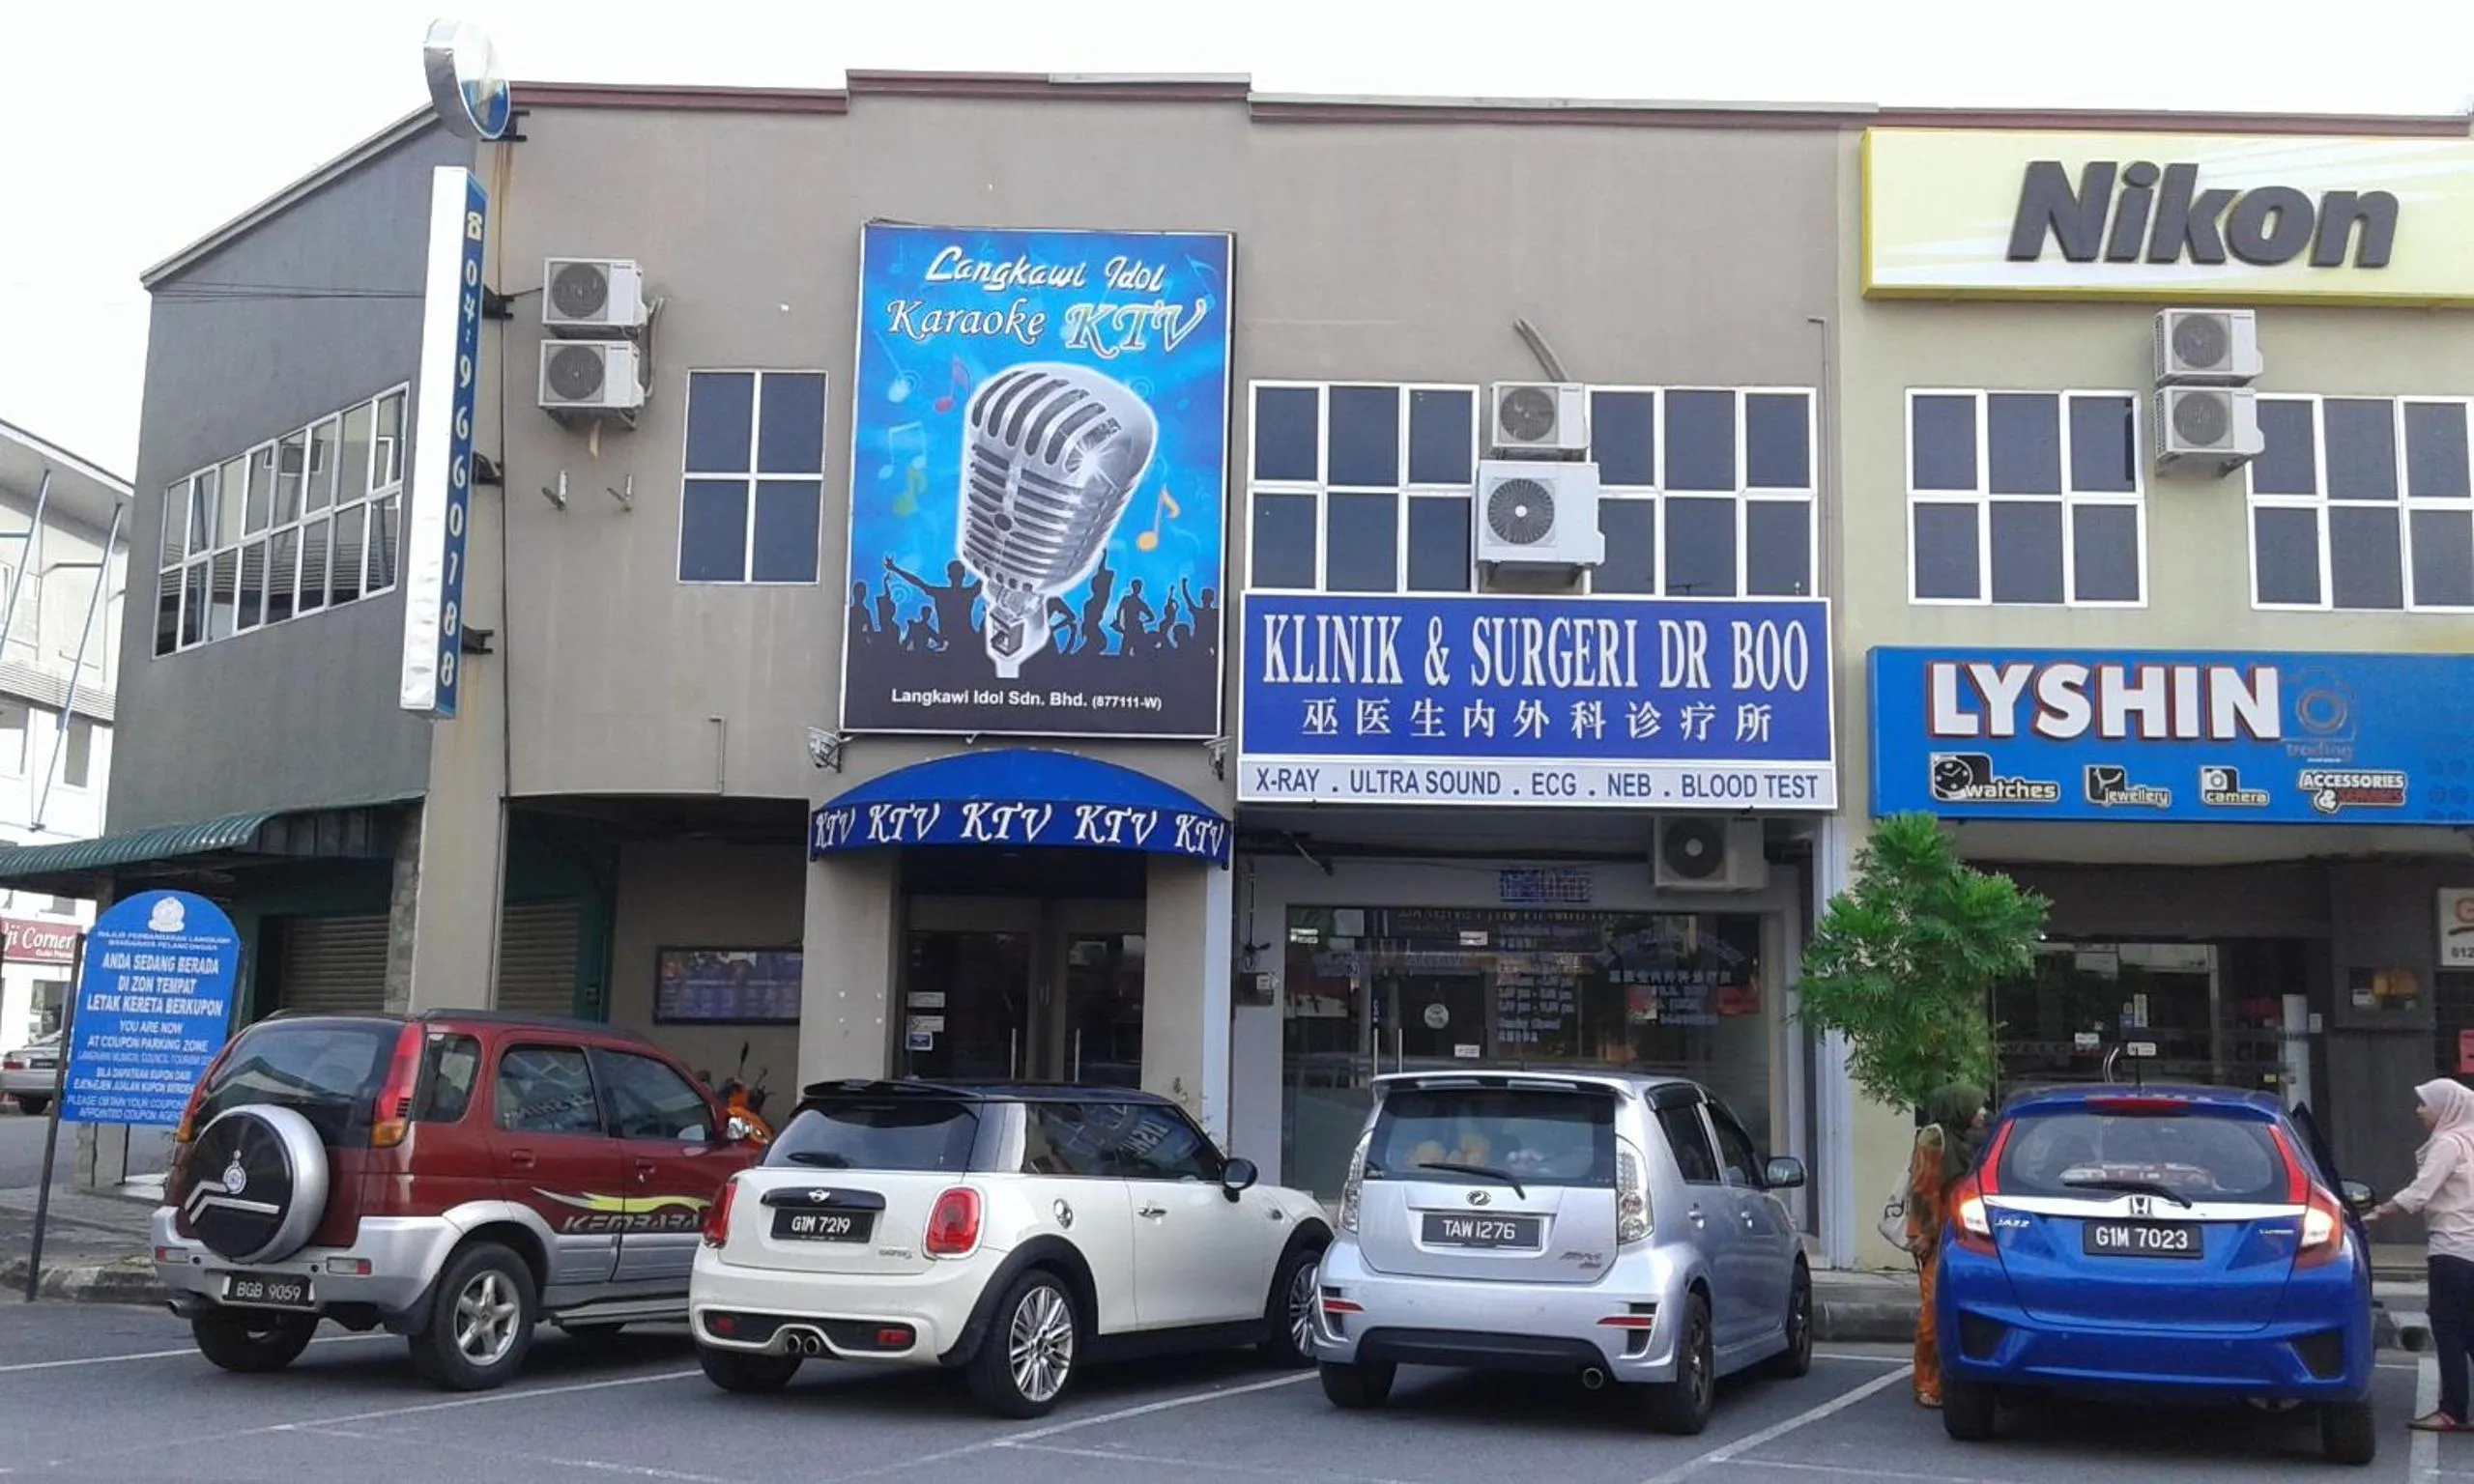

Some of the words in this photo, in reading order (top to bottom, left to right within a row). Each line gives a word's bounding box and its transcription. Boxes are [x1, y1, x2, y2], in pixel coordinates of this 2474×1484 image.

[2005, 160, 2400, 269] Nikon
[925, 245, 1086, 292] Langkawi
[1105, 256, 1165, 292] Idol
[885, 298, 1046, 344] Karaoke
[1064, 300, 1208, 359] KTV
[1263, 614, 1403, 685] KLINIK
[1424, 616, 1450, 687] &
[1471, 615, 1637, 690] SURGERI
[1659, 618, 1712, 690] DR
[1732, 619, 1809, 693] BOO
[891, 689, 968, 706] Langkawi
[973, 690, 1004, 704] Idol
[1008, 691, 1045, 706] Sdn.
[1050, 692, 1087, 706] Bhd.
[1092, 696, 1163, 711] (877111-W)
[1928, 661, 2282, 741] LYSHIN
[1301, 698, 1773, 744] 巫医生内外科诊疗所
[1255, 768, 1320, 793] X-RAY
[1349, 769, 1420, 794] ULTRA
[1425, 771, 1501, 796] SOUND
[1531, 772, 1577, 797] ECG
[1607, 773, 1653, 798] NEB
[1682, 774, 1759, 800] BLOOD
[1764, 775, 1819, 800] TEST
[1966, 781, 2057, 799] watches
[2303, 773, 2404, 788] ACCESSORIES
[2103, 787, 2169, 805] jewellery
[2206, 791, 2267, 803] camera
[2318, 788, 2337, 809] &
[815, 808, 856, 849] KTV
[867, 802, 941, 842] KTV
[962, 802, 1053, 843] KTV
[1074, 804, 1158, 845] KTV
[1174, 813, 1225, 857] KTV
[22, 926, 75, 950] Corner
[102, 953, 131, 970] ANDA
[133, 954, 176, 972] SEDANG
[178, 956, 220, 975] BERADA
[118, 975, 129, 991] DI
[131, 976, 155, 992] ZON
[156, 977, 197, 994] TEMPAT
[87, 993, 121, 1012] LETAK
[123, 995, 163, 1013] KERETA
[165, 997, 224, 1016] BERKUPON
[119, 1020, 139, 1033] YOU
[140, 1021, 159, 1033] ARE
[160, 1022, 185, 1034] NOW
[87, 1035, 100, 1048] AT
[101, 1036, 140, 1049] COUPON
[141, 1038, 182, 1050] PARKING
[183, 1040, 210, 1053] ZONE
[561, 1213, 700, 1233] KEMBARA
[819, 1216, 851, 1234] 7219
[1443, 1219, 1473, 1238] TAW
[1475, 1221, 1516, 1241] 1276
[2095, 1226, 2128, 1247] G1M
[2135, 1227, 2189, 1250] 7023
[236, 1281, 264, 1298] BGB
[268, 1283, 302, 1303] 9059
